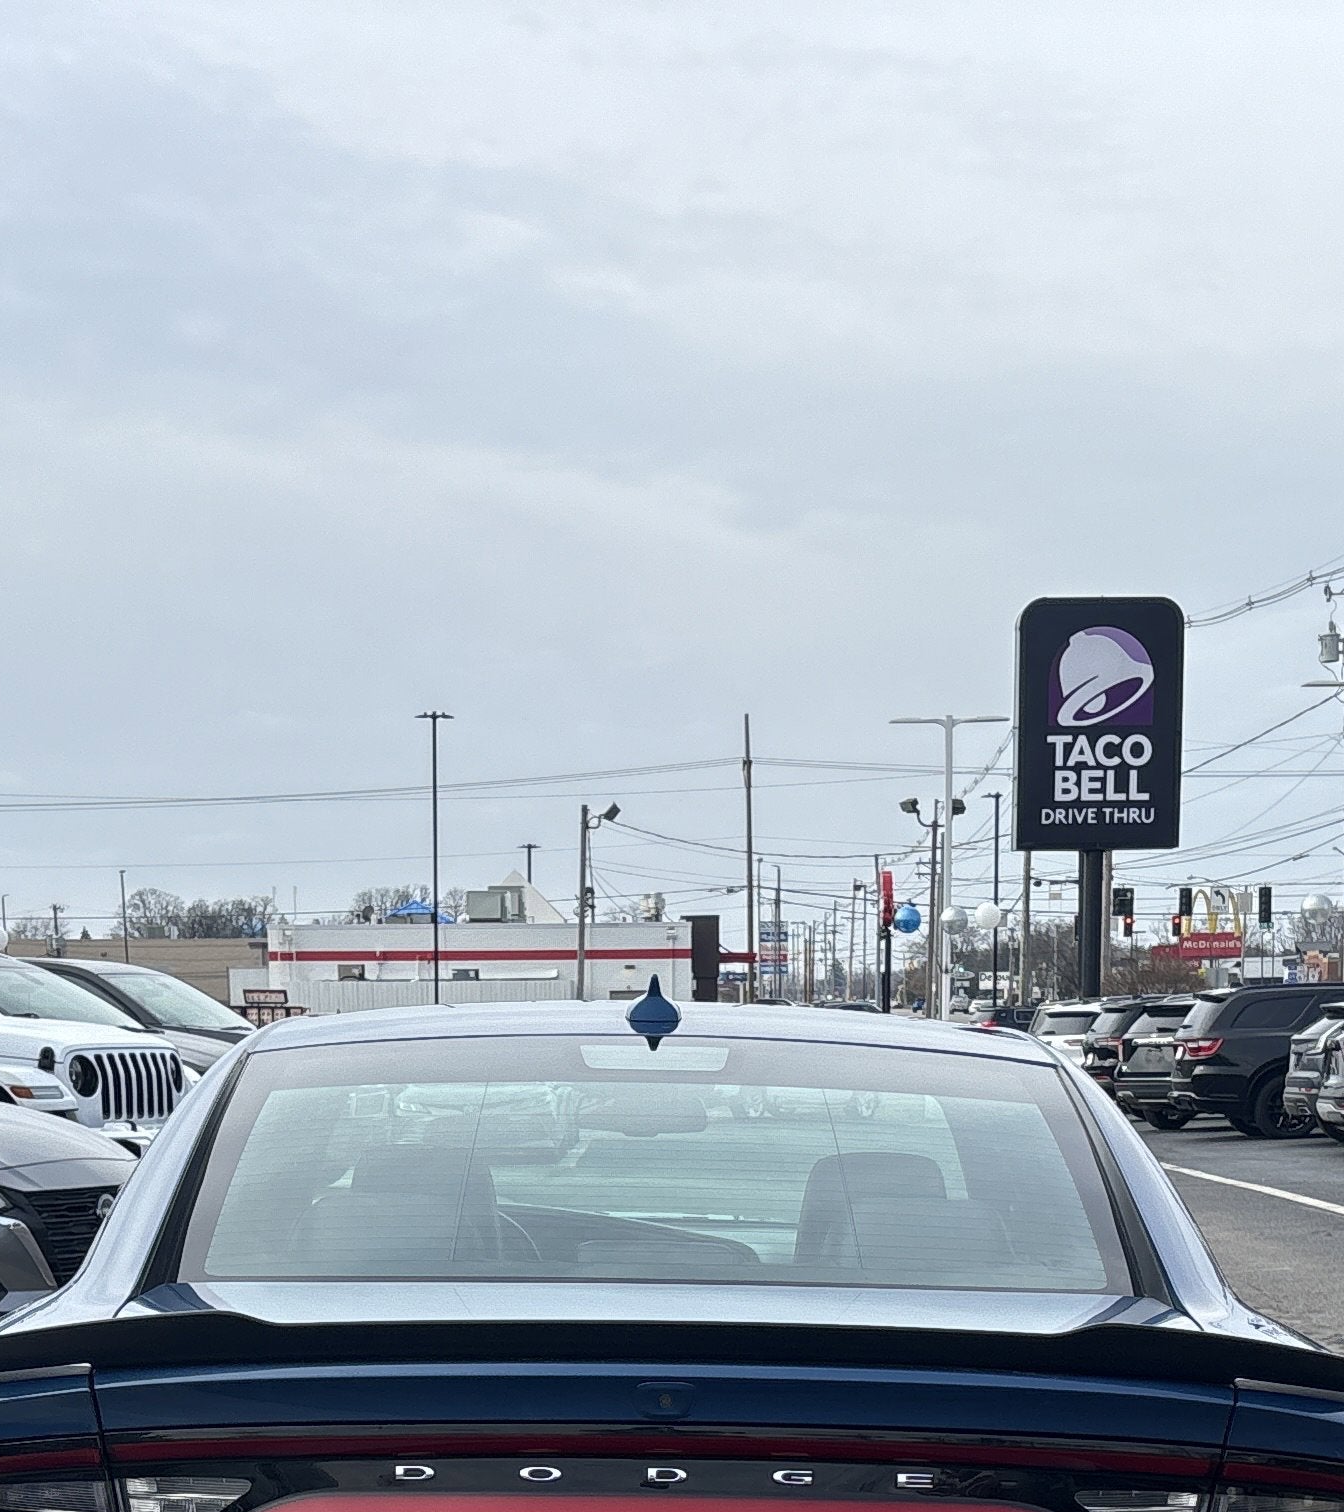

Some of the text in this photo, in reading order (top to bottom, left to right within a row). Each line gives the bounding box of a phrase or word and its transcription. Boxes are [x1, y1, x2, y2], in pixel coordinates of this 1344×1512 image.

[1046, 734, 1153, 767] TACO
[1054, 769, 1150, 801] BELL
[1041, 807, 1155, 825] DRIVE THRU
[394, 1464, 936, 1490] DODGE
